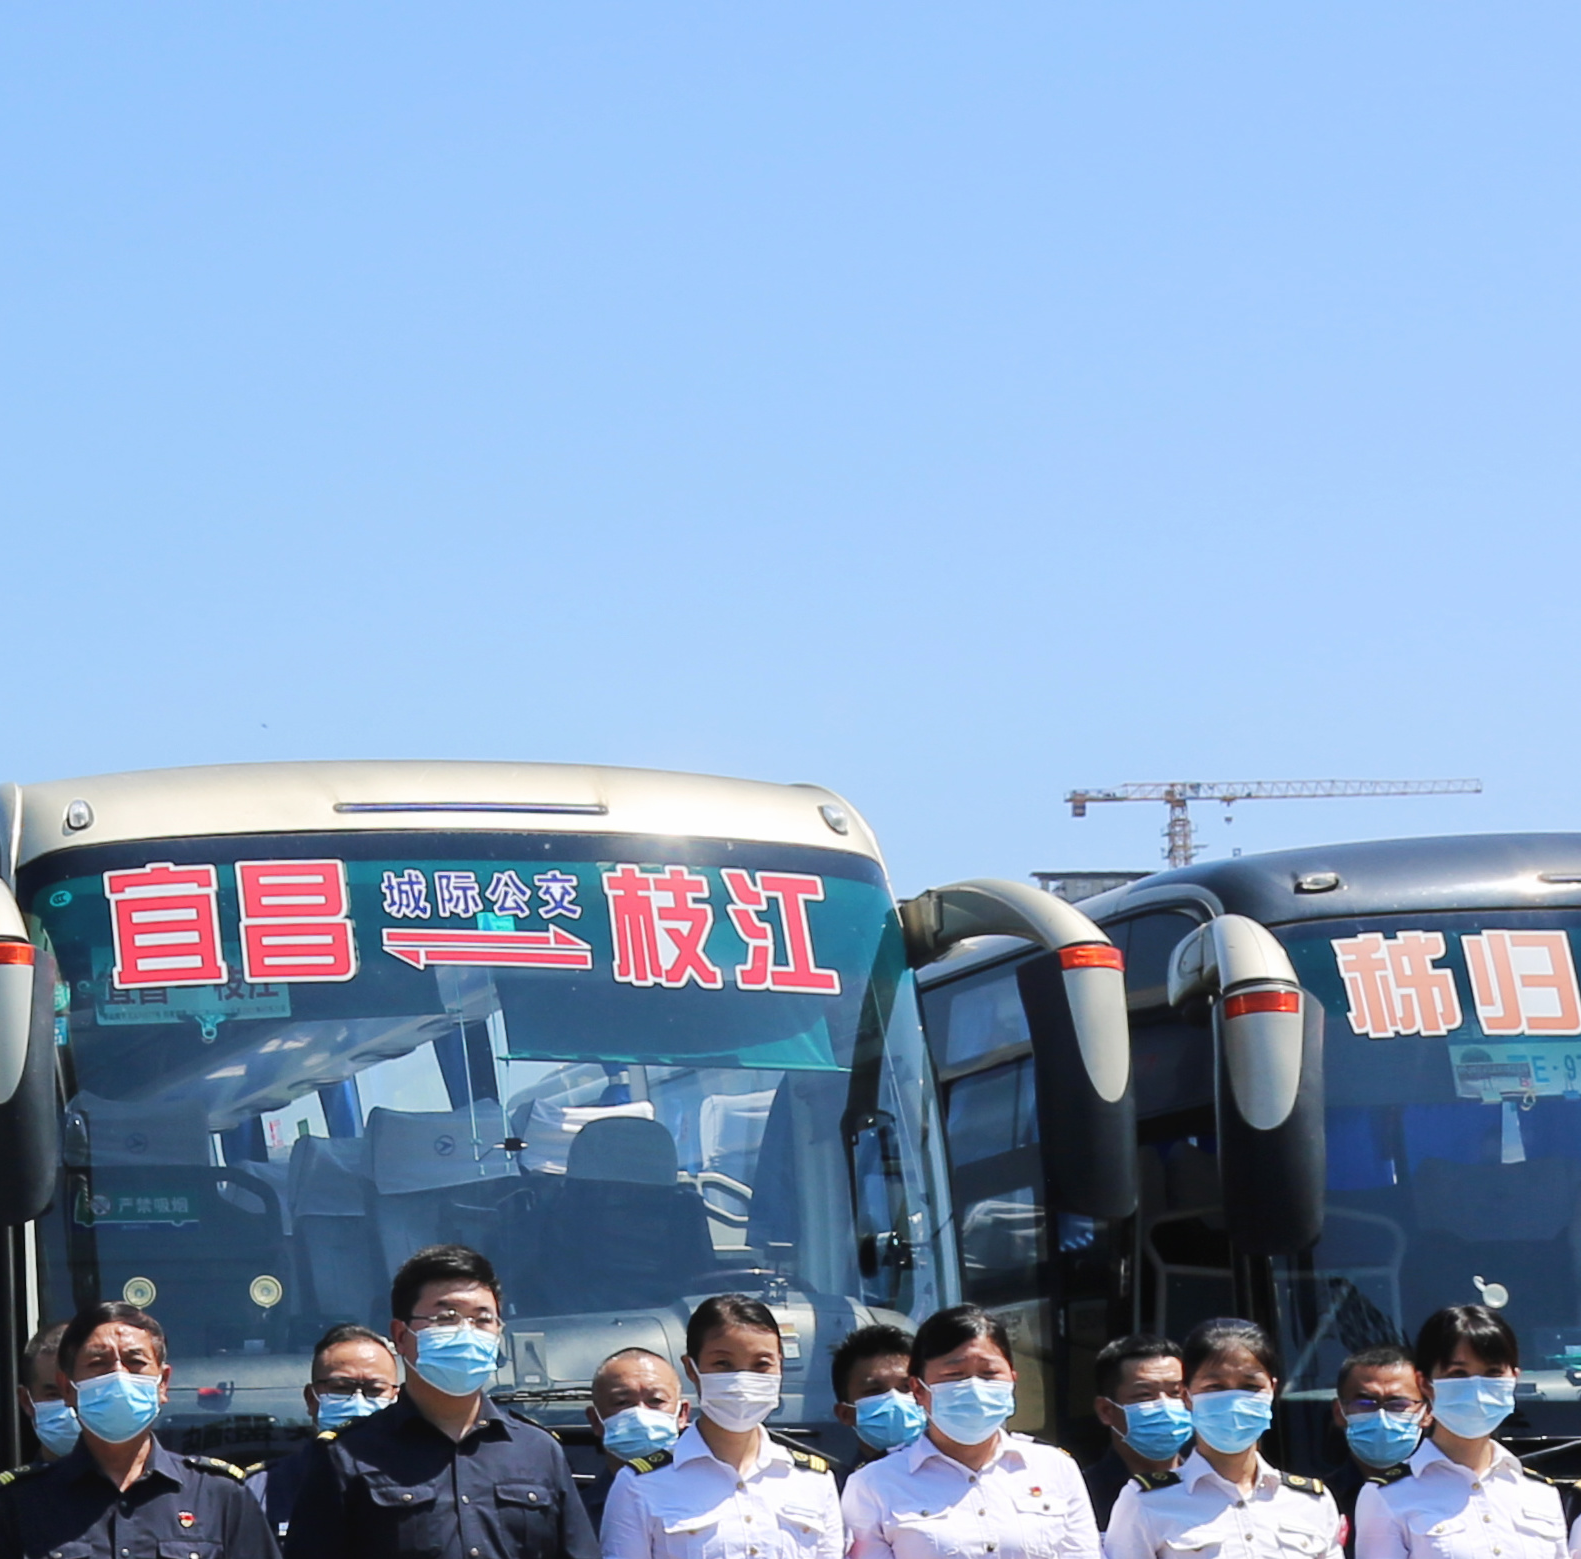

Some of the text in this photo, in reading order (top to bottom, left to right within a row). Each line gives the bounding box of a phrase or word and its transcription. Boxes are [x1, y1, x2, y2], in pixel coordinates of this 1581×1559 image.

[103, 859, 841, 995] 宜昌 城际公交 枝江
[1331, 929, 1581, 1039] 秭归
